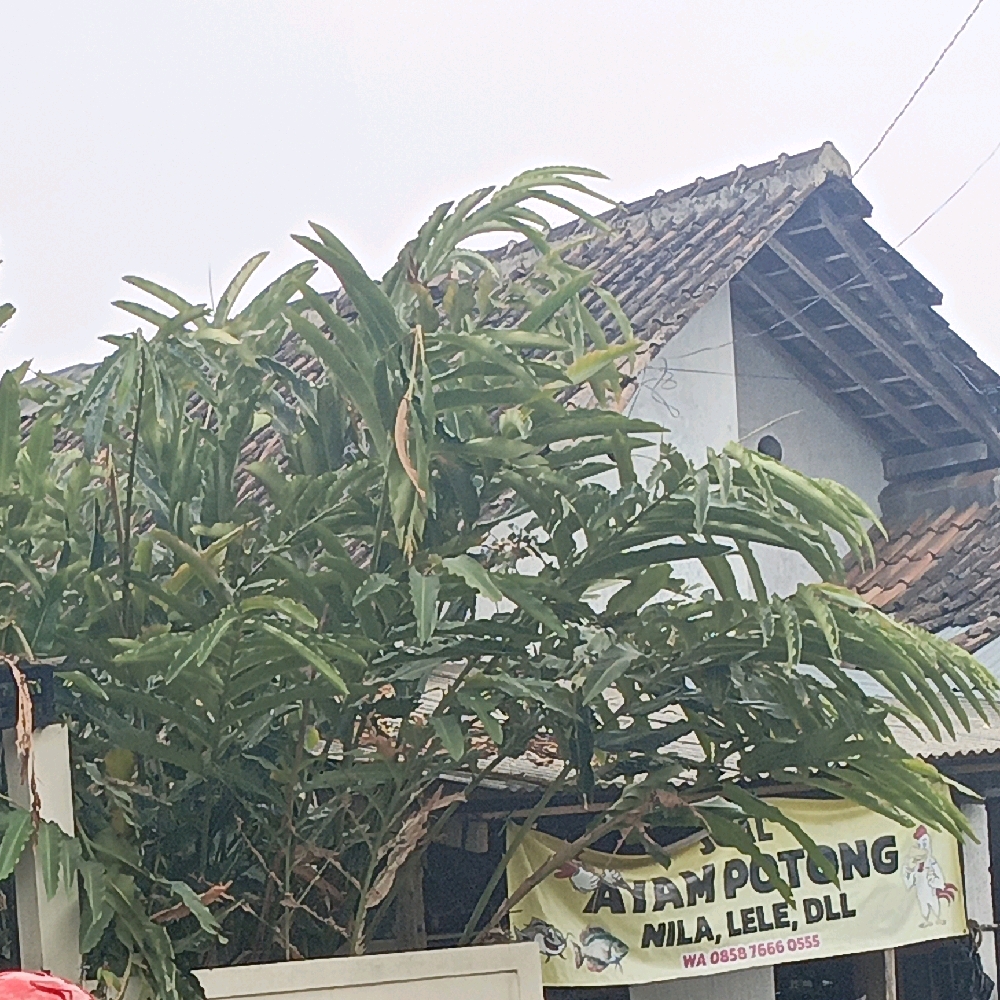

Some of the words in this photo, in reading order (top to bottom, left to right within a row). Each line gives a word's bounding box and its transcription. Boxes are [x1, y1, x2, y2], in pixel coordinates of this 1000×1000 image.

[700, 817, 773, 855] JL
[724, 835, 899, 899] POTONG
[641, 916, 722, 949] NILA,
[726, 902, 799, 938] LELE,
[803, 893, 857, 925] DLL
[682, 953, 707, 969] WA
[710, 946, 748, 965] 0858
[751, 939, 785, 959] 7666
[787, 934, 821, 952] 0555
